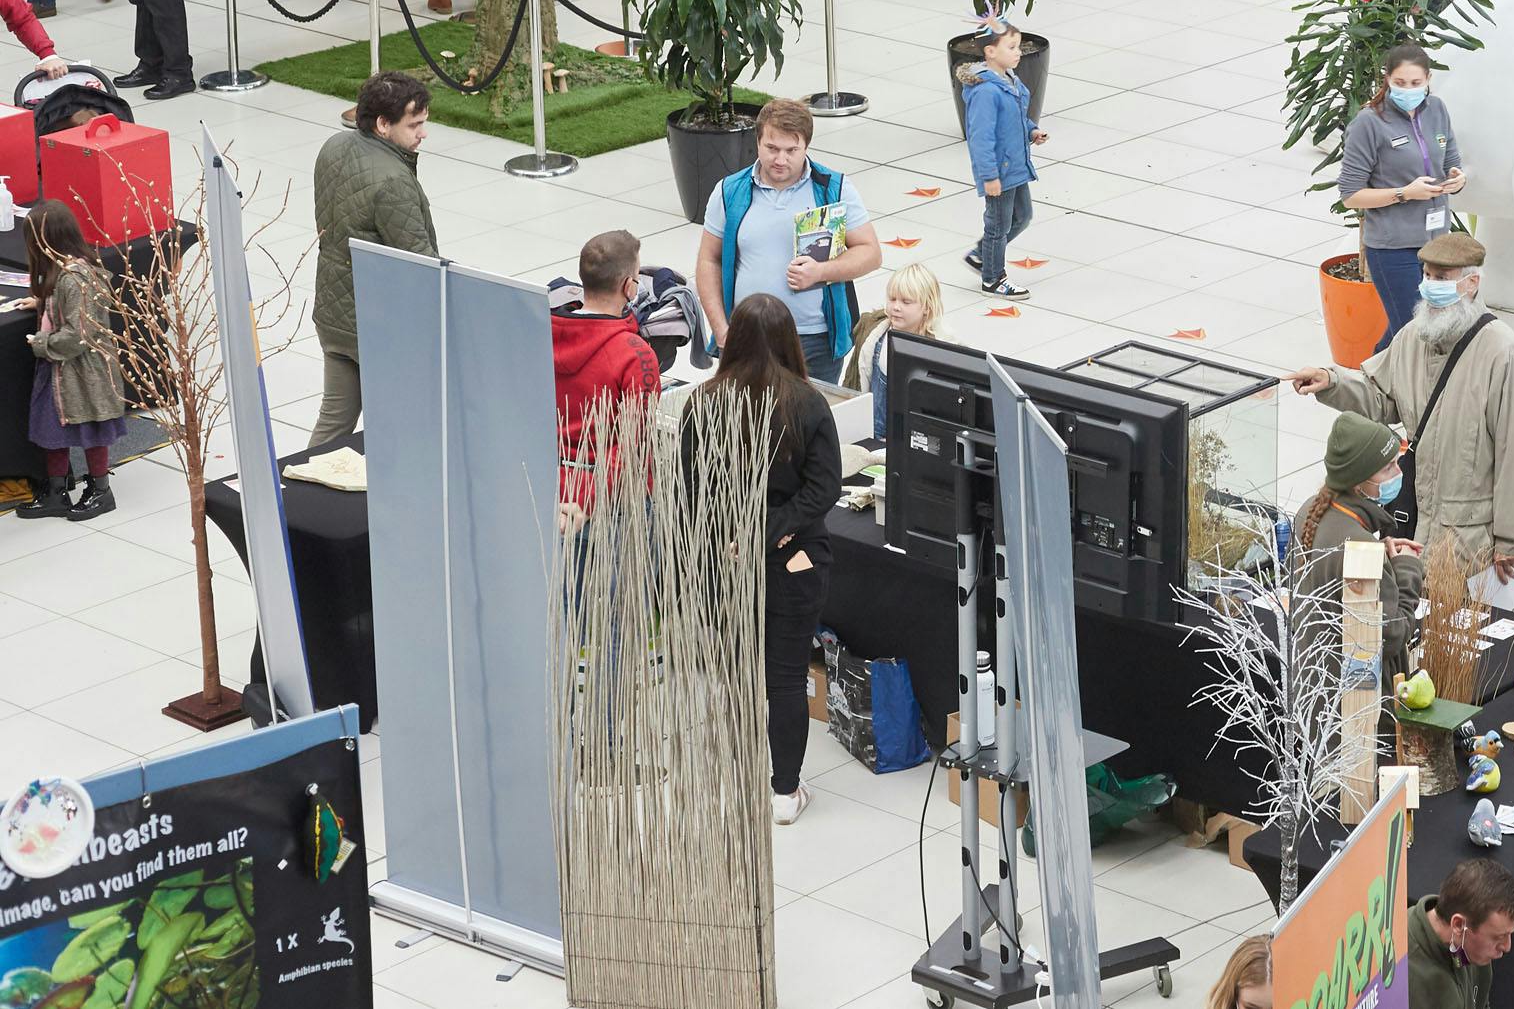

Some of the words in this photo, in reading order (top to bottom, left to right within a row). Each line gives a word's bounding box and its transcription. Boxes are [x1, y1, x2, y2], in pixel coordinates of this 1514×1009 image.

[61, 885, 96, 905] can
[99, 872, 134, 899] you
[137, 858, 162, 883] find
[168, 844, 212, 869] them
[216, 827, 248, 854] all?
[1290, 809, 1404, 1009] OARR!
[279, 964, 321, 983] Amphibian
[323, 958, 353, 973] species
